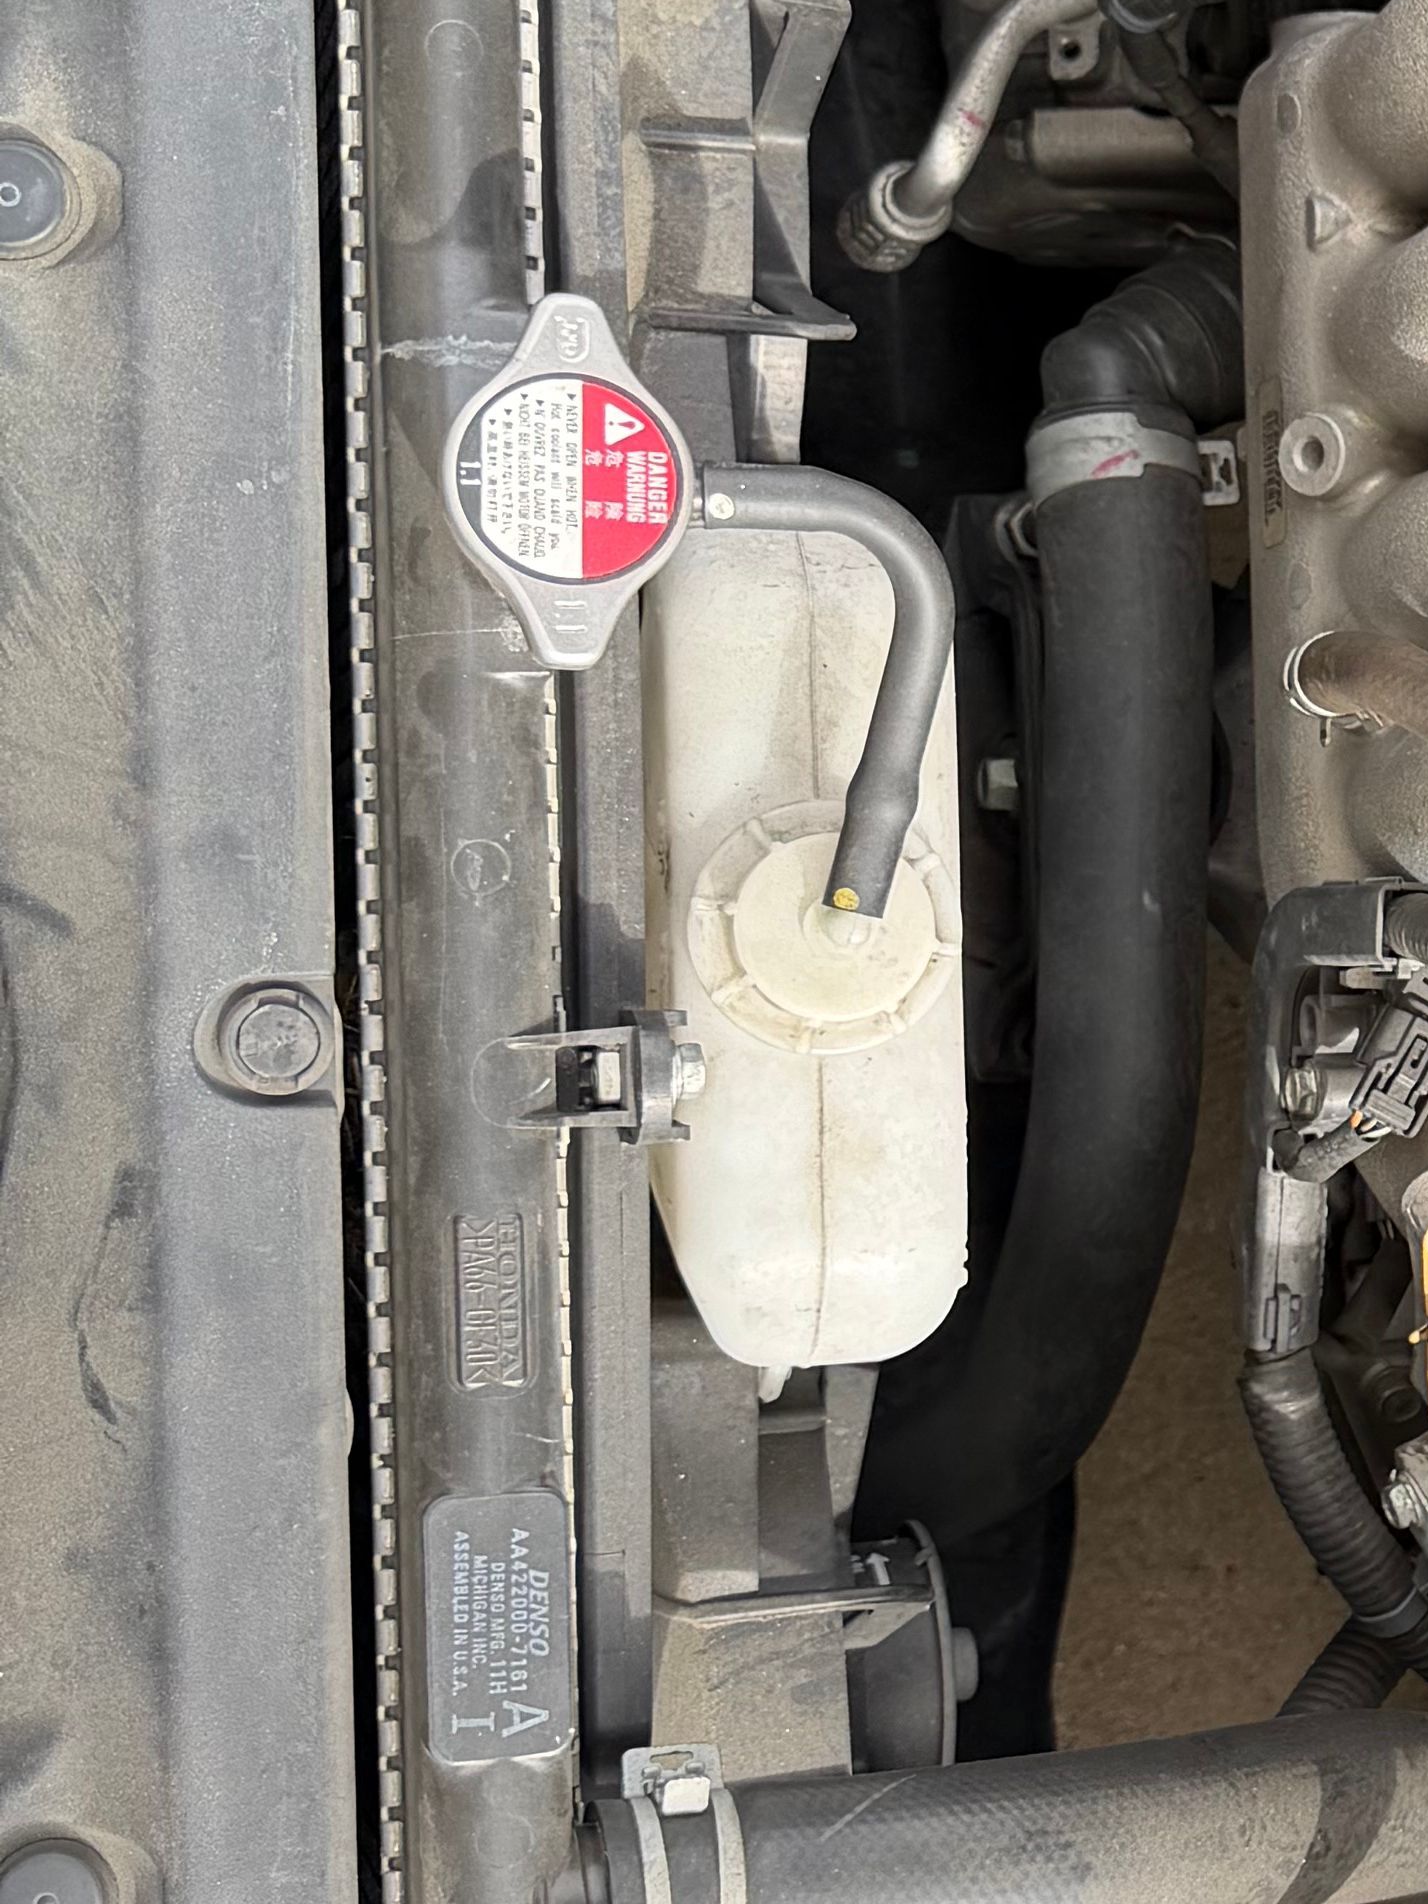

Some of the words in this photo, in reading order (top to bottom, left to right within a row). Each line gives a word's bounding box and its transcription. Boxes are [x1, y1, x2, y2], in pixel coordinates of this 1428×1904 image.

[565, 405, 578, 434] NEVER
[459, 461, 482, 486] 1.1
[565, 442, 578, 467] OPEN
[626, 451, 647, 524] WARNUNG
[648, 452, 668, 525] DANGER
[499, 1216, 522, 1381] HONDA
[452, 1531, 470, 1623] ASSEMBLED
[471, 1555, 488, 1632] MICHIGAN
[490, 1562, 505, 1613] DENSO
[510, 1528, 530, 1692] AA422000-7161
[528, 1569, 550, 1657] DENSO
[453, 1629, 469, 1646] IN
[472, 1638, 487, 1669] INC.
[490, 1618, 505, 1655] MFG.
[452, 1651, 467, 1696] U.S.A.
[489, 1659, 507, 1694] 11H
[502, 1700, 550, 1738] A
